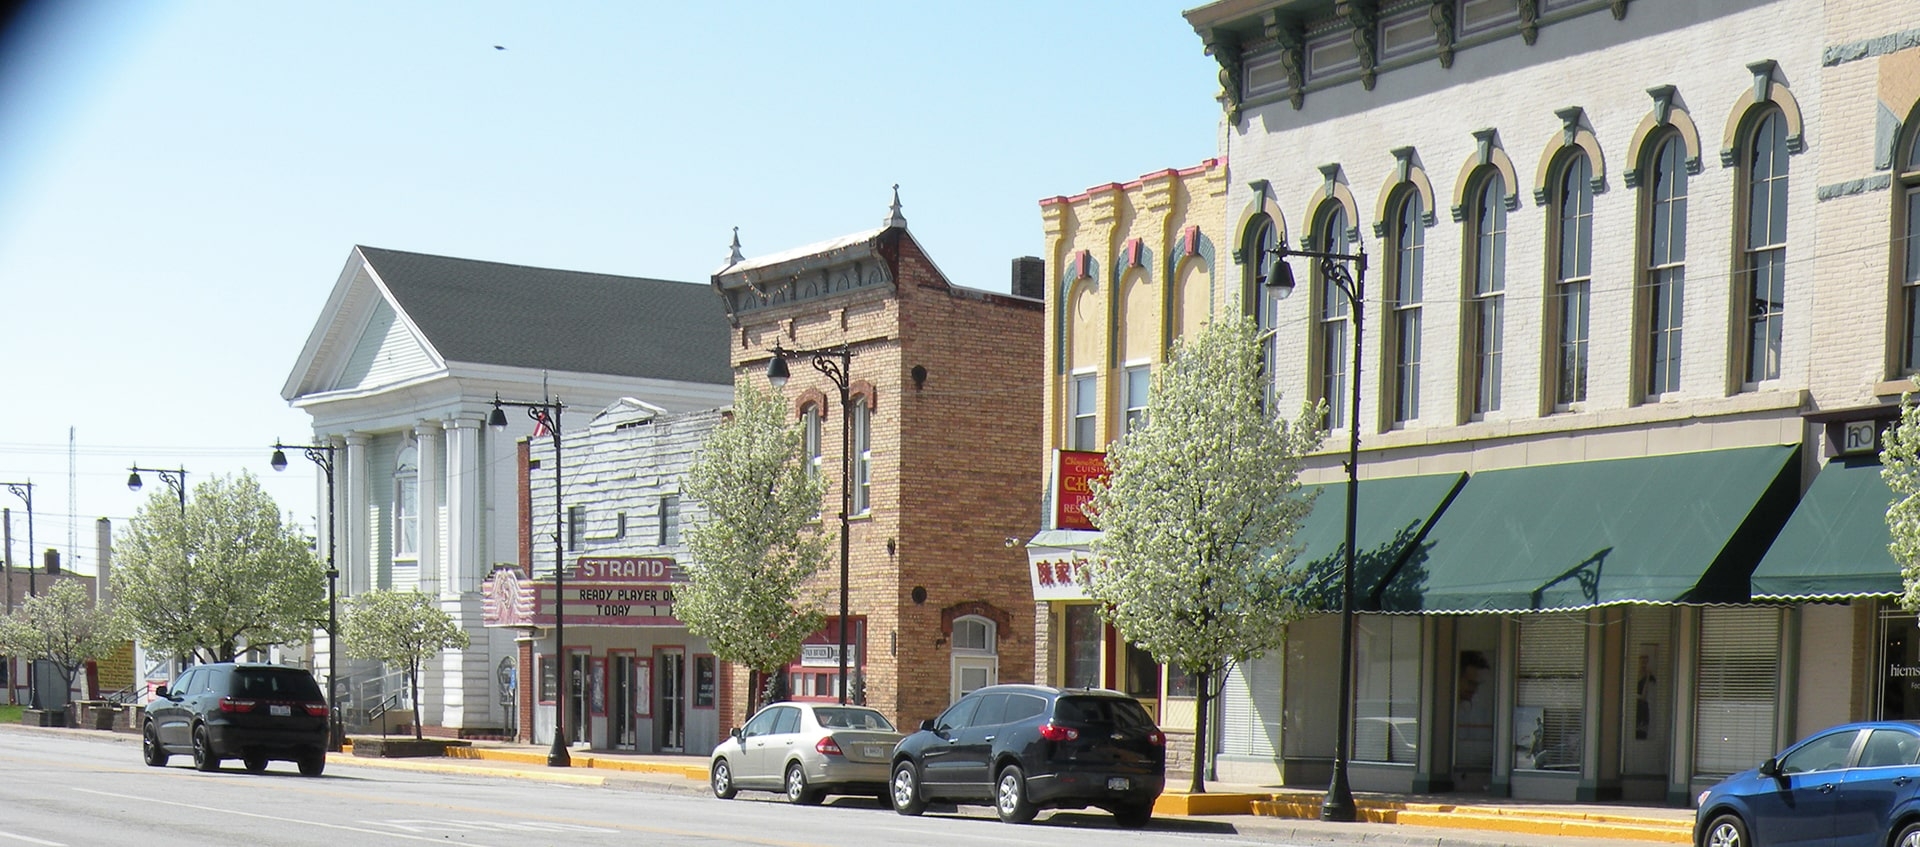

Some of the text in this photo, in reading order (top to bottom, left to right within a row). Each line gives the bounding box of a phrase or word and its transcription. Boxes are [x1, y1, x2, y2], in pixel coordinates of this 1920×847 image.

[1075, 465, 1106, 473] CUISIN
[583, 559, 664, 577] STRAND
[580, 589, 676, 600] READY PLAYER ON
[596, 605, 630, 616] TODAY
